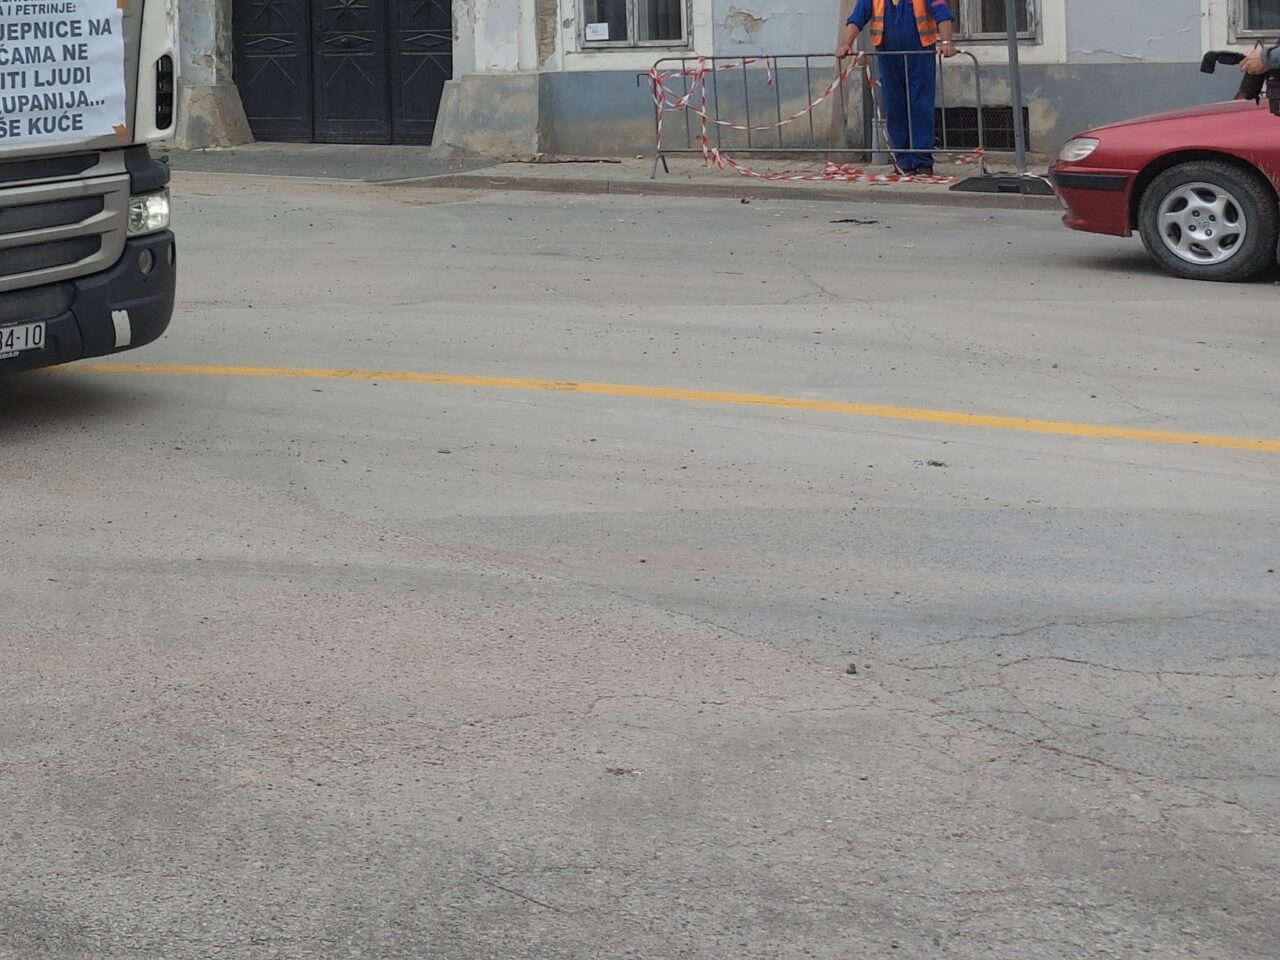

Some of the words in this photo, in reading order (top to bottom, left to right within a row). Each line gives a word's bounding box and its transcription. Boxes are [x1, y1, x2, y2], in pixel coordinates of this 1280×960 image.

[7, 4, 12, 16] I
[15, 2, 76, 16] PETRINJE:
[88, 18, 112, 36] NA
[61, 43, 88, 61] NE
[34, 66, 91, 87] LJUDI
[28, 111, 84, 136] KUĆE
